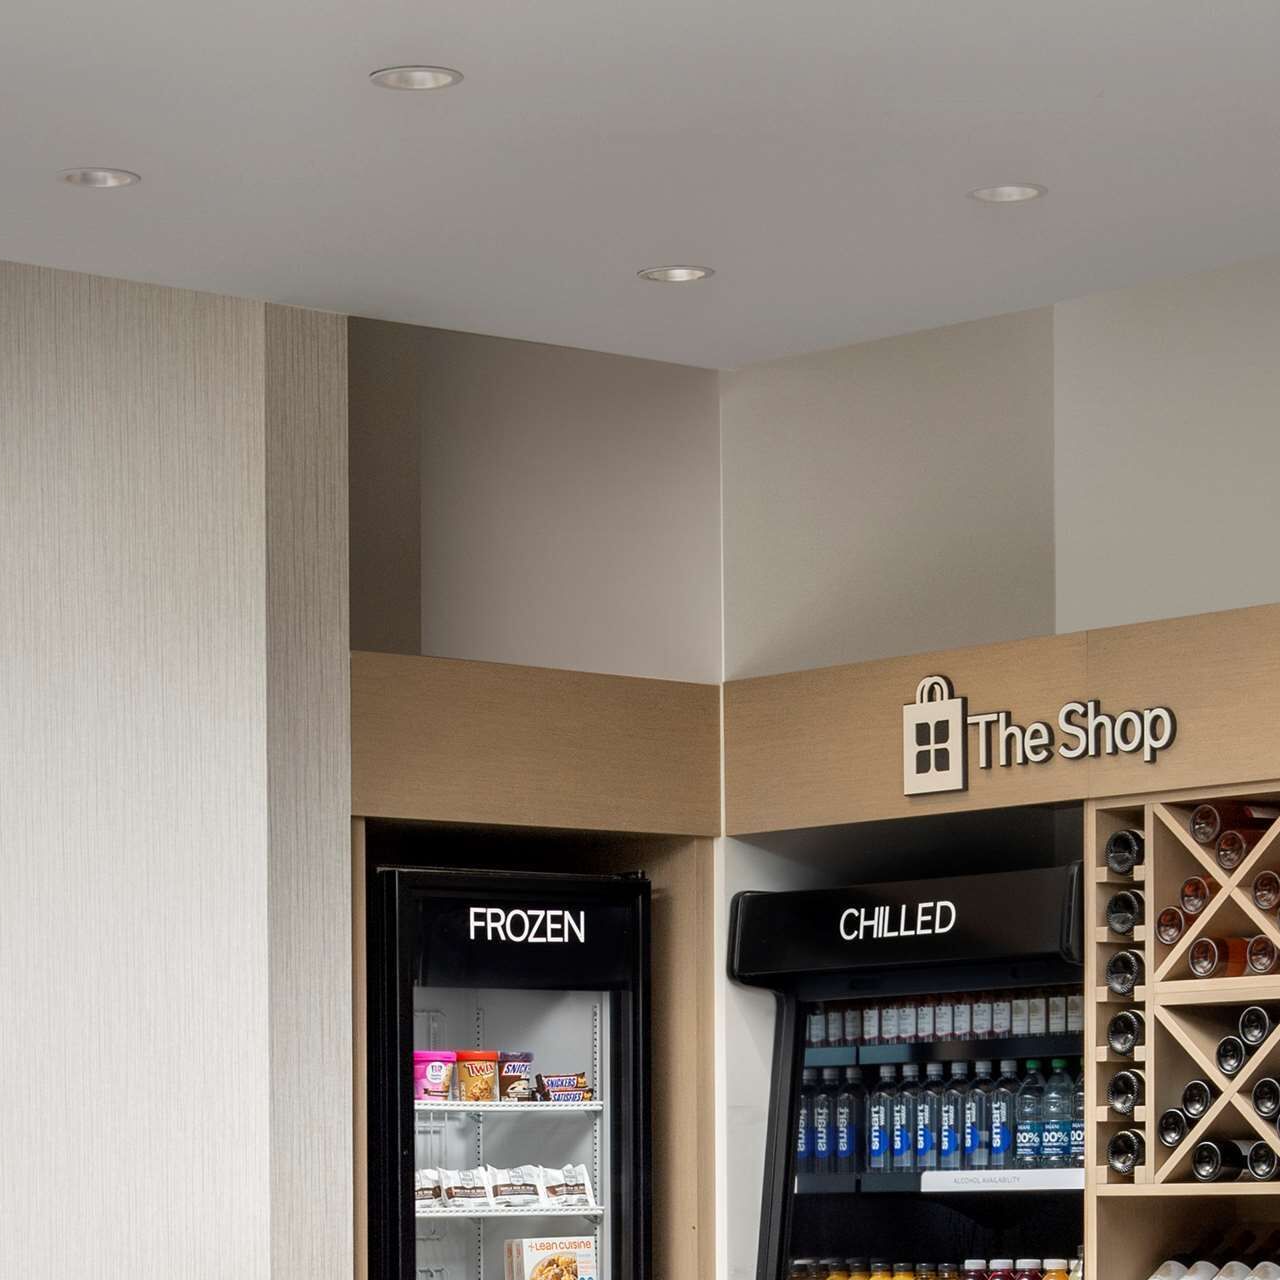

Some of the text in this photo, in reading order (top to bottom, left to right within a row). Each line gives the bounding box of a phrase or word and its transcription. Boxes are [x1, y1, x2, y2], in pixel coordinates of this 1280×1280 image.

[967, 700, 1176, 769] The Shop
[469, 907, 586, 944] FROZEN
[839, 901, 957, 941] CHILLED
[871, 1105, 880, 1150] smart
[941, 1105, 949, 1150] smart
[992, 1102, 1000, 1148] smart
